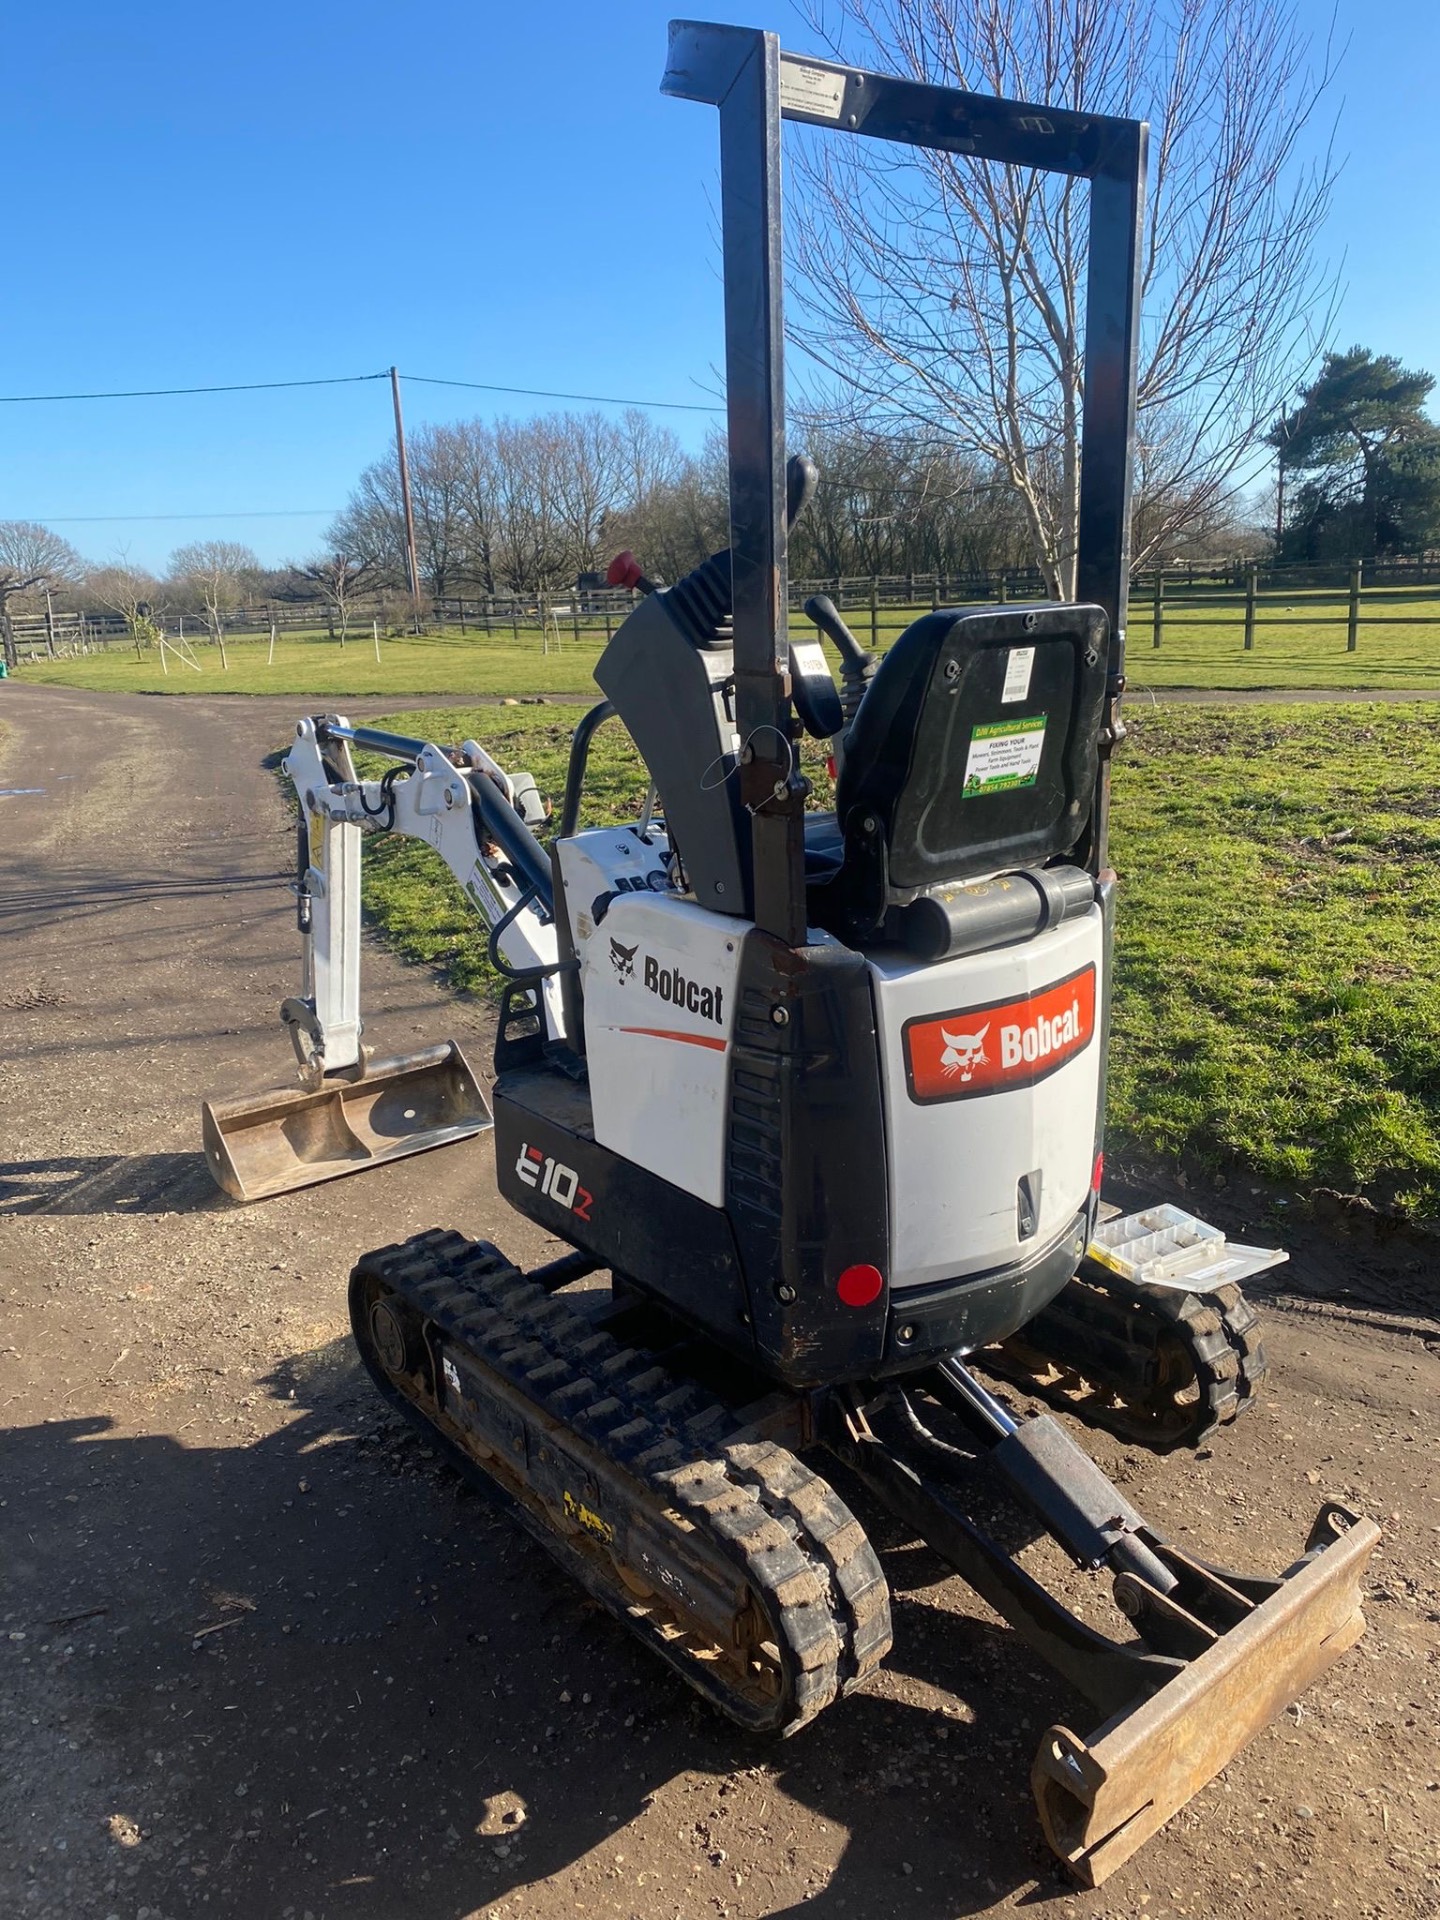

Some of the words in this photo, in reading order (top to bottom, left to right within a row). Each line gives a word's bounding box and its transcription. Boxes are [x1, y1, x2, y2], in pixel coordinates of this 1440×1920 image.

[988, 724, 1021, 735] Agricultural
[1022, 720, 1043, 728] Services
[989, 740, 1008, 748] FIXING
[644, 955, 723, 1025] Bobcat
[1001, 999, 1080, 1069] Bobcat
